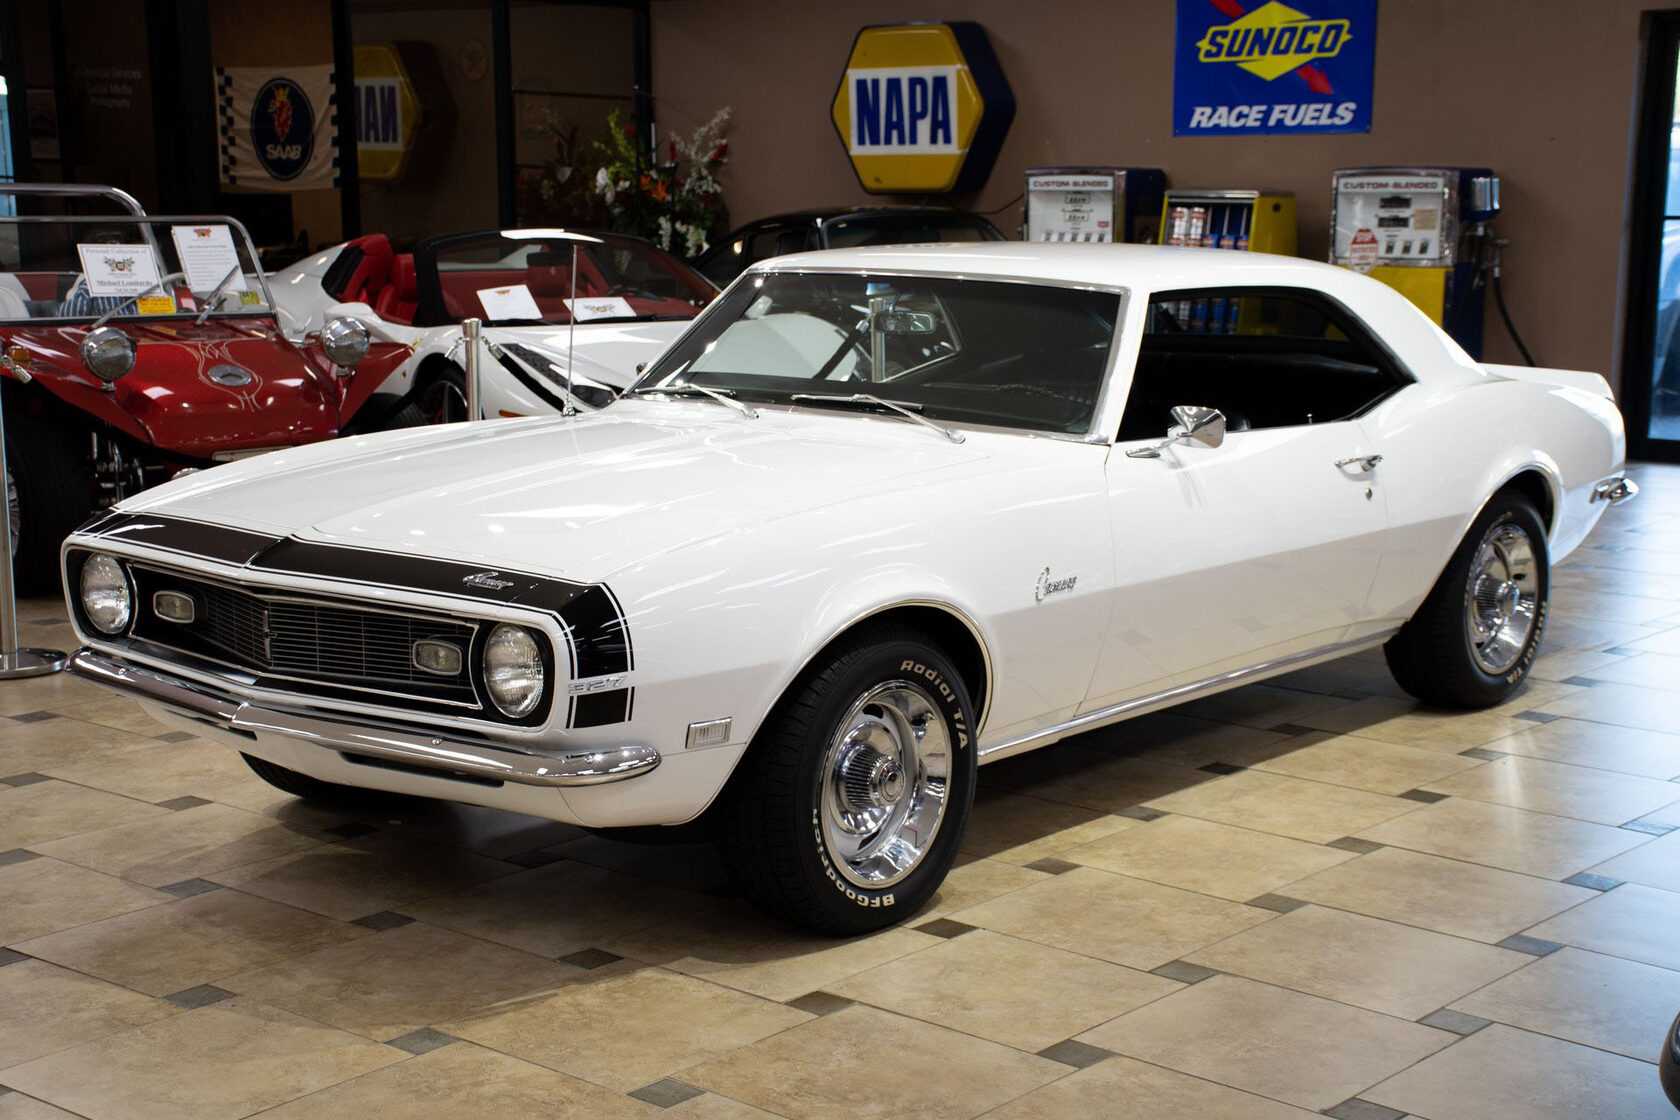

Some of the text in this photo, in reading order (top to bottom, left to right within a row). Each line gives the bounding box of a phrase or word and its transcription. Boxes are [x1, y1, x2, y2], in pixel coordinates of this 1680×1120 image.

[1203, 23, 1345, 58] SUNOCO
[855, 75, 952, 146] NAPA
[1189, 102, 1357, 128] RACE FUELS
[266, 144, 301, 159] SAAB
[1343, 182, 1389, 190] CUSTOM
[569, 673, 627, 694] 327
[900, 660, 968, 748] Radial T/A
